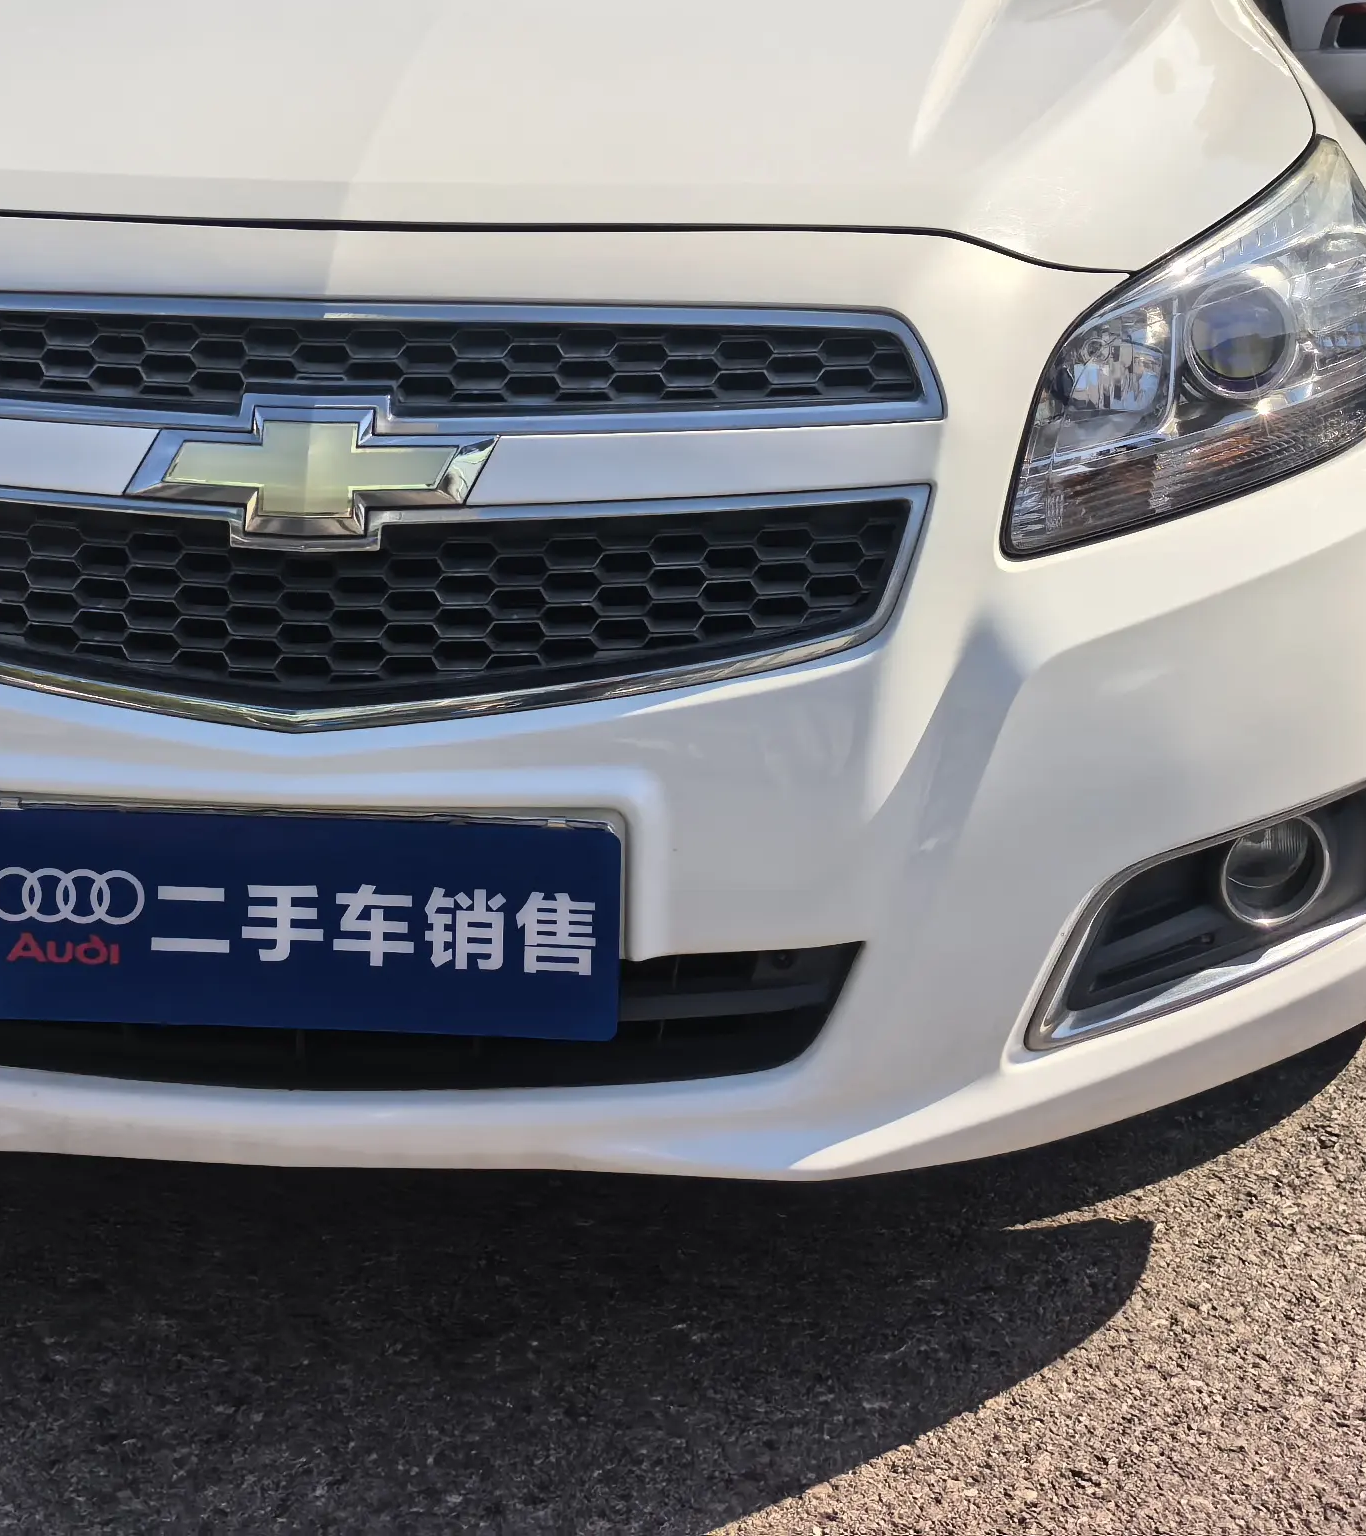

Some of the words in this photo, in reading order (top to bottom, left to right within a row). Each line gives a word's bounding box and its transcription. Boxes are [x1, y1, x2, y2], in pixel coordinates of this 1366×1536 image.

[5, 931, 121, 966] Audi
[150, 884, 597, 976] 二手车销售
